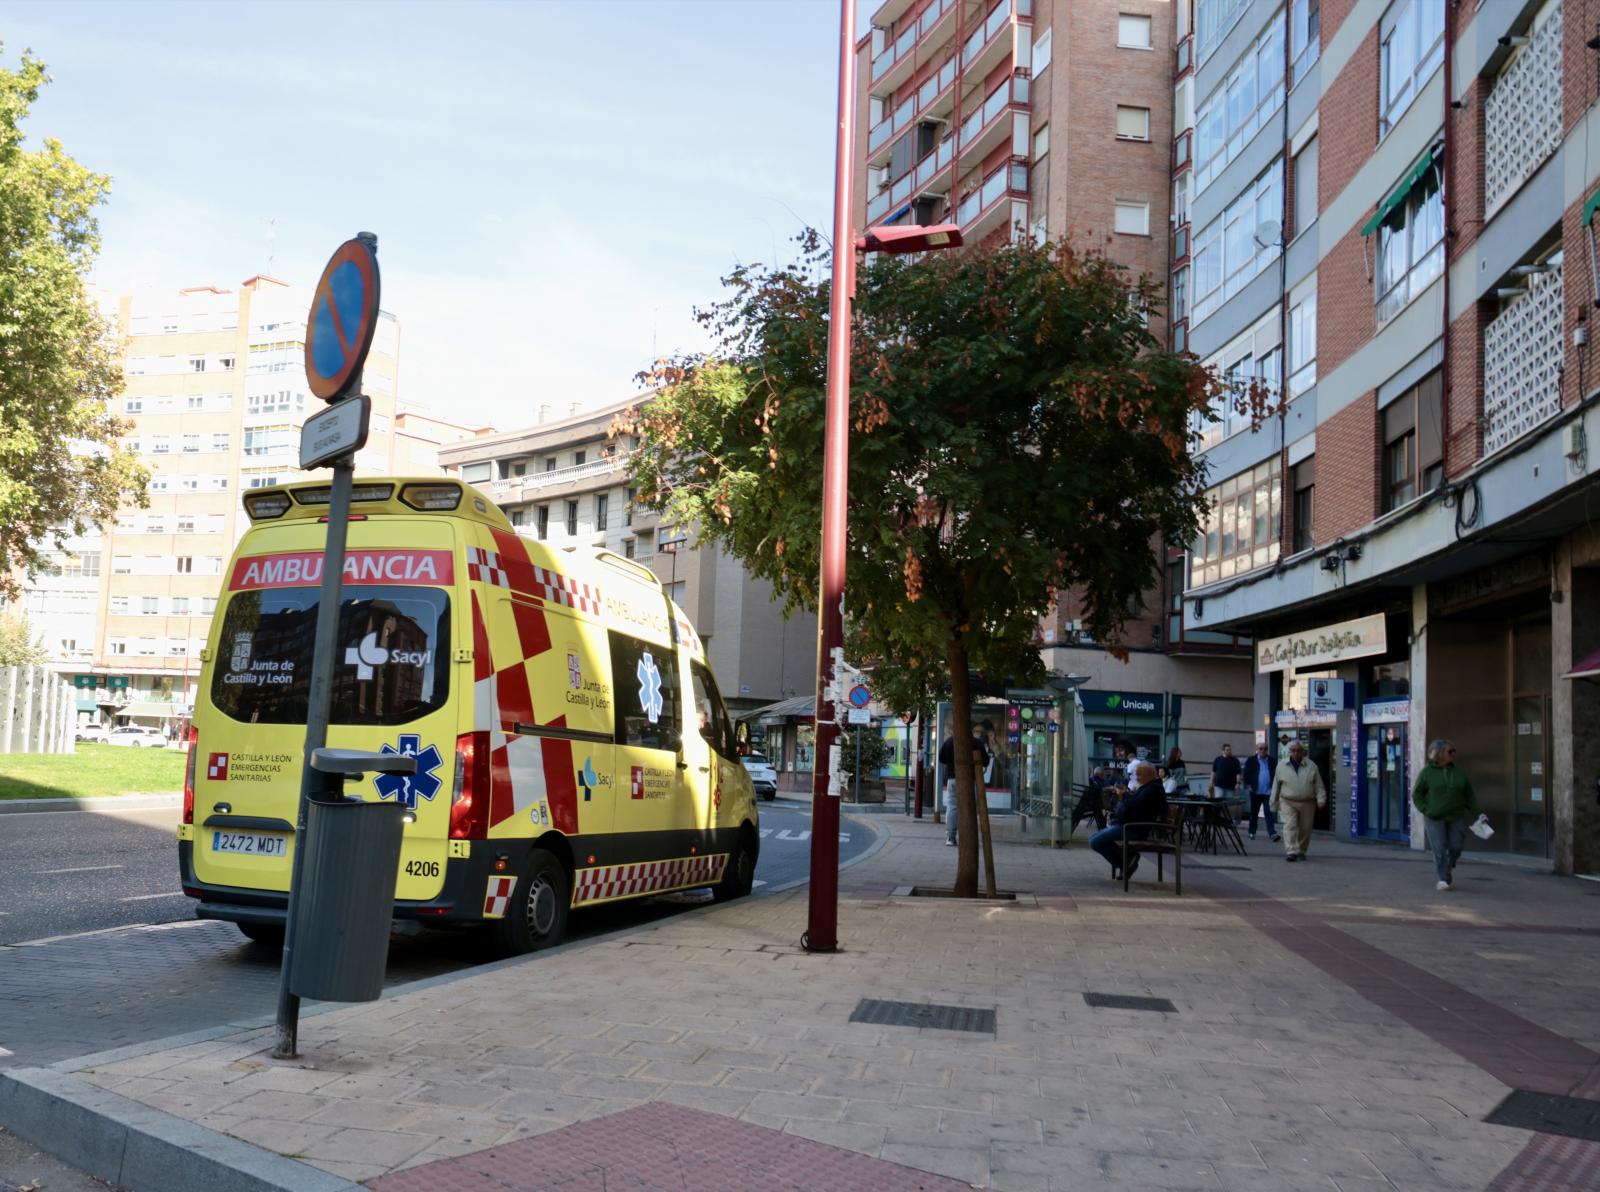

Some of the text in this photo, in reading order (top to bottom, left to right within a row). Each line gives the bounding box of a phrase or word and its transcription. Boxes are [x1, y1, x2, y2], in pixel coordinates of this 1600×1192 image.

[241, 555, 438, 585] AMBUANCIA
[250, 660, 295, 671] Junta de
[391, 649, 431, 667] Sacyl
[223, 672, 293, 687] Castilla y León
[583, 678, 601, 693] Junta
[566, 690, 589, 706] Castilla
[1122, 700, 1155, 712] Unicaja
[231, 753, 264, 762] CASTILLA
[271, 754, 292, 763] LEÓN
[231, 763, 281, 773] EMERGENCIAS
[229, 773, 272, 783] SANITARIAS
[221, 834, 284, 854] 2472 MDT
[405, 861, 440, 877] 4206
